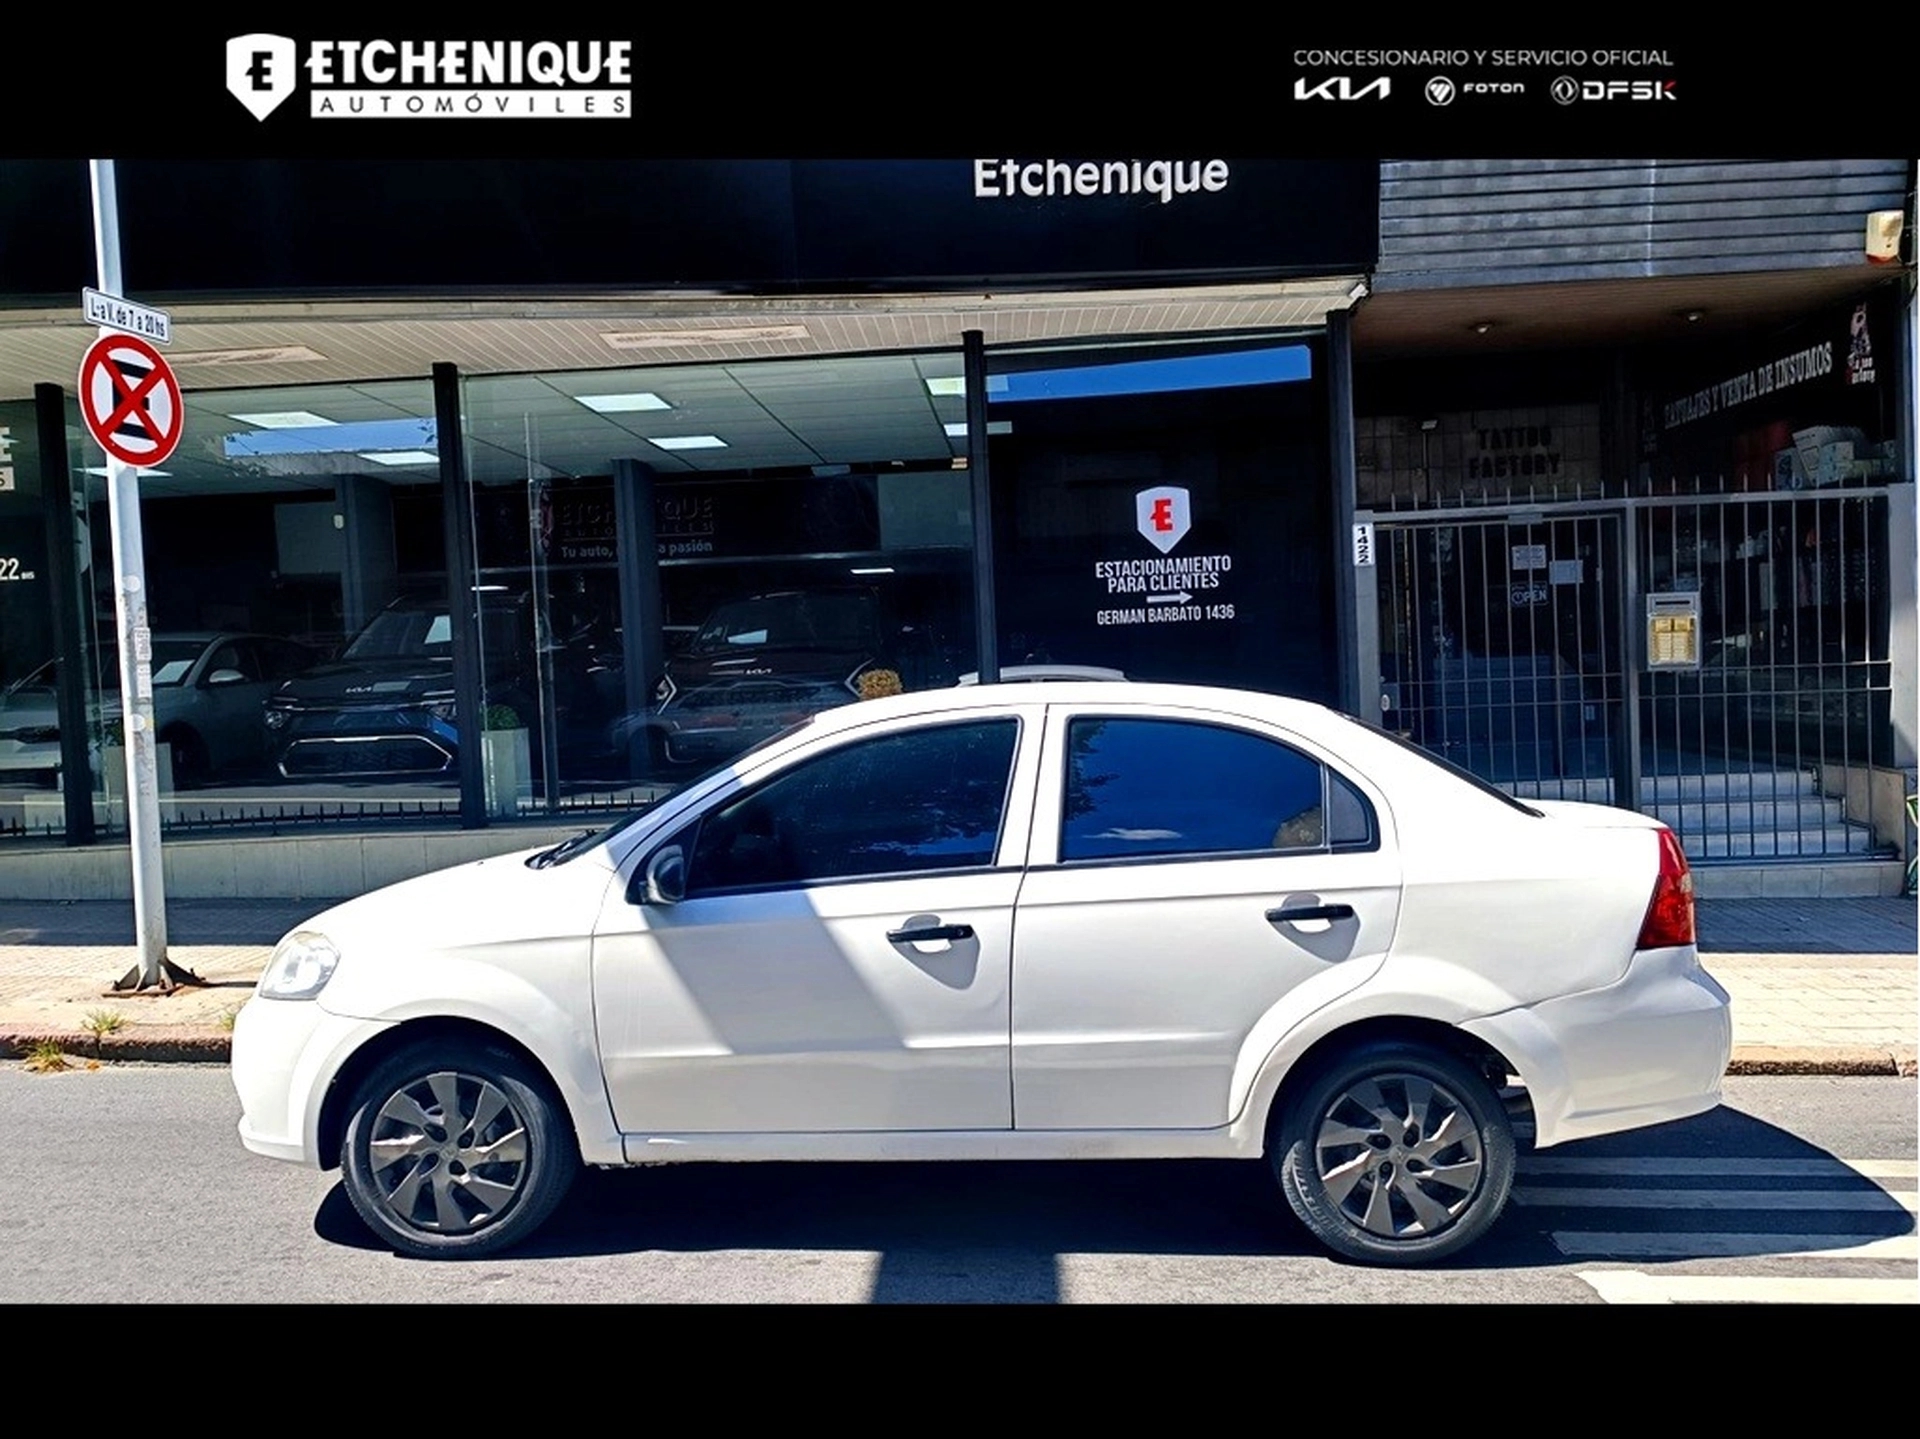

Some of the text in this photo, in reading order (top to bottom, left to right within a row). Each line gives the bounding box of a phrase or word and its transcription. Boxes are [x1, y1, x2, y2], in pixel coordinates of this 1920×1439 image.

[974, 158, 1229, 203] Etchenique
[117, 306, 126, 325] de
[145, 314, 154, 333] 20
[1720, 372, 1756, 409] VENTA
[1757, 363, 1774, 396] DE
[1775, 341, 1832, 390] INSUMOS
[1469, 453, 1560, 480] FACTORY
[561, 546, 576, 559] Tu
[669, 538, 713, 557] pasión
[1357, 526, 1369, 565] 1422
[1095, 554, 1232, 578] ESTACIONAMIENTO
[1108, 571, 1220, 593] PARA CLIENTES
[1097, 603, 1235, 625] GERMAN BARBATO 1436
